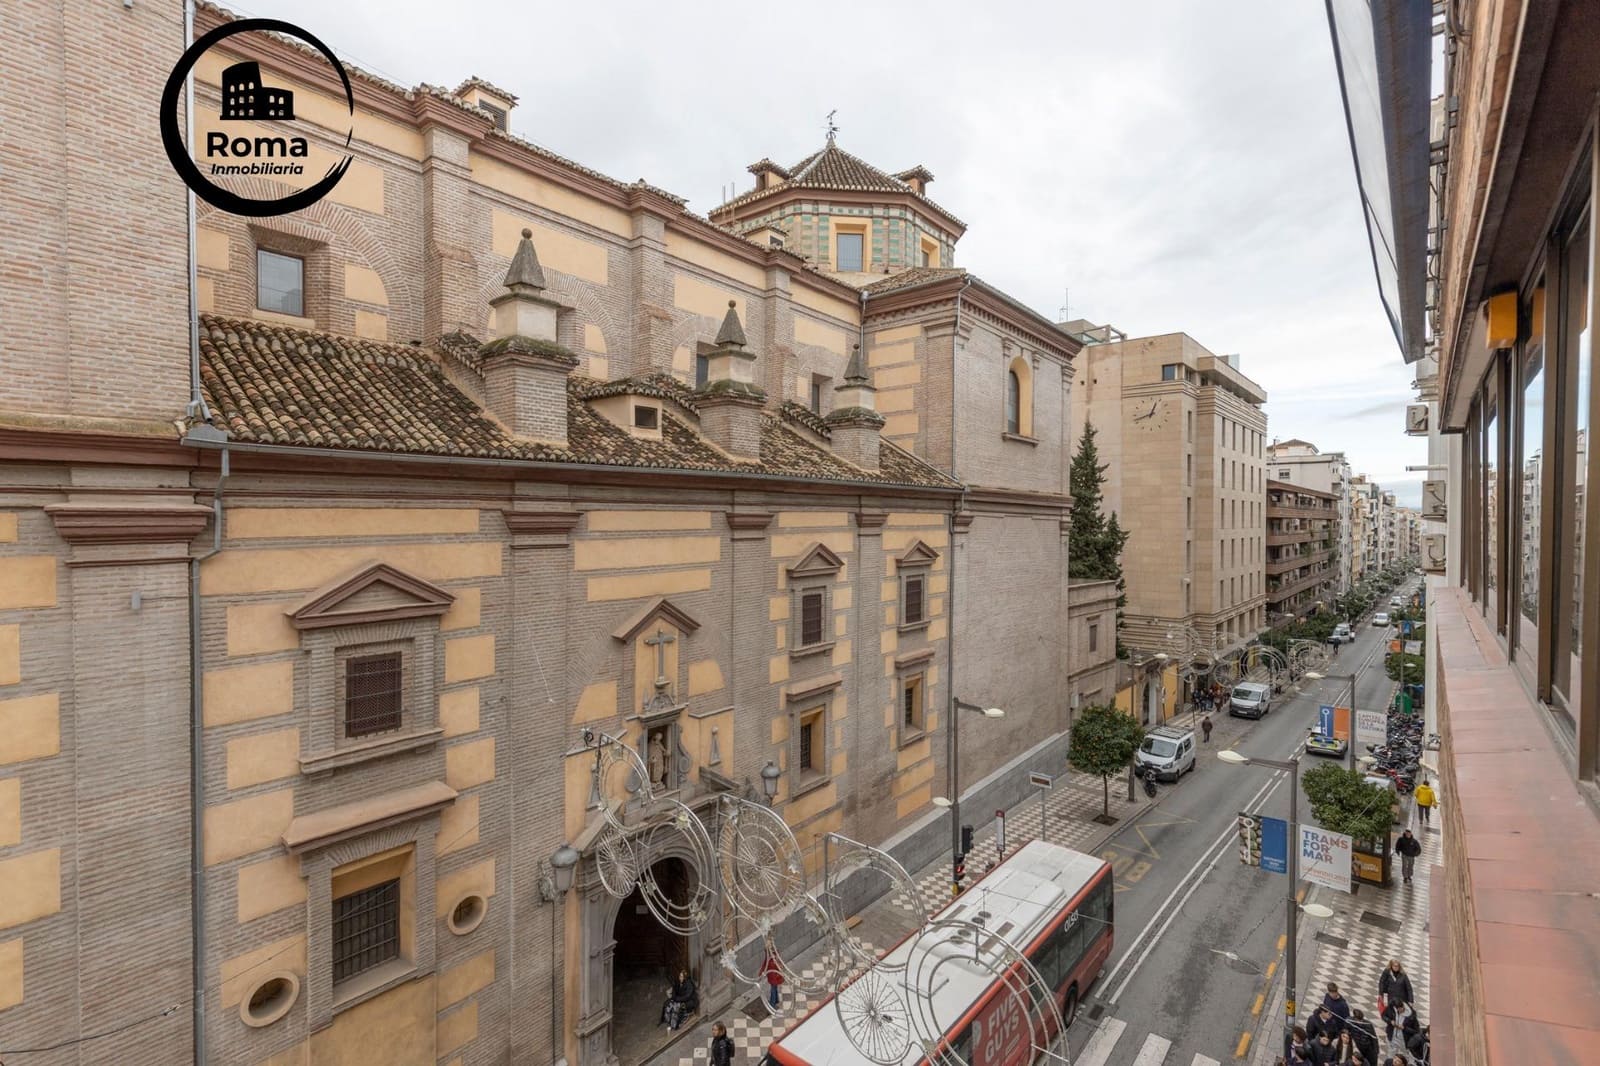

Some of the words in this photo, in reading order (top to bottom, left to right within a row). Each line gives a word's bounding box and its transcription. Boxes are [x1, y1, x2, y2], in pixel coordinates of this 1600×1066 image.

[1303, 830, 1348, 850] TRANS
[1303, 839, 1330, 854] FOR
[1303, 849, 1333, 864] MAR
[988, 991, 1017, 1038] FIVE
[985, 1009, 1019, 1063] GUYS
